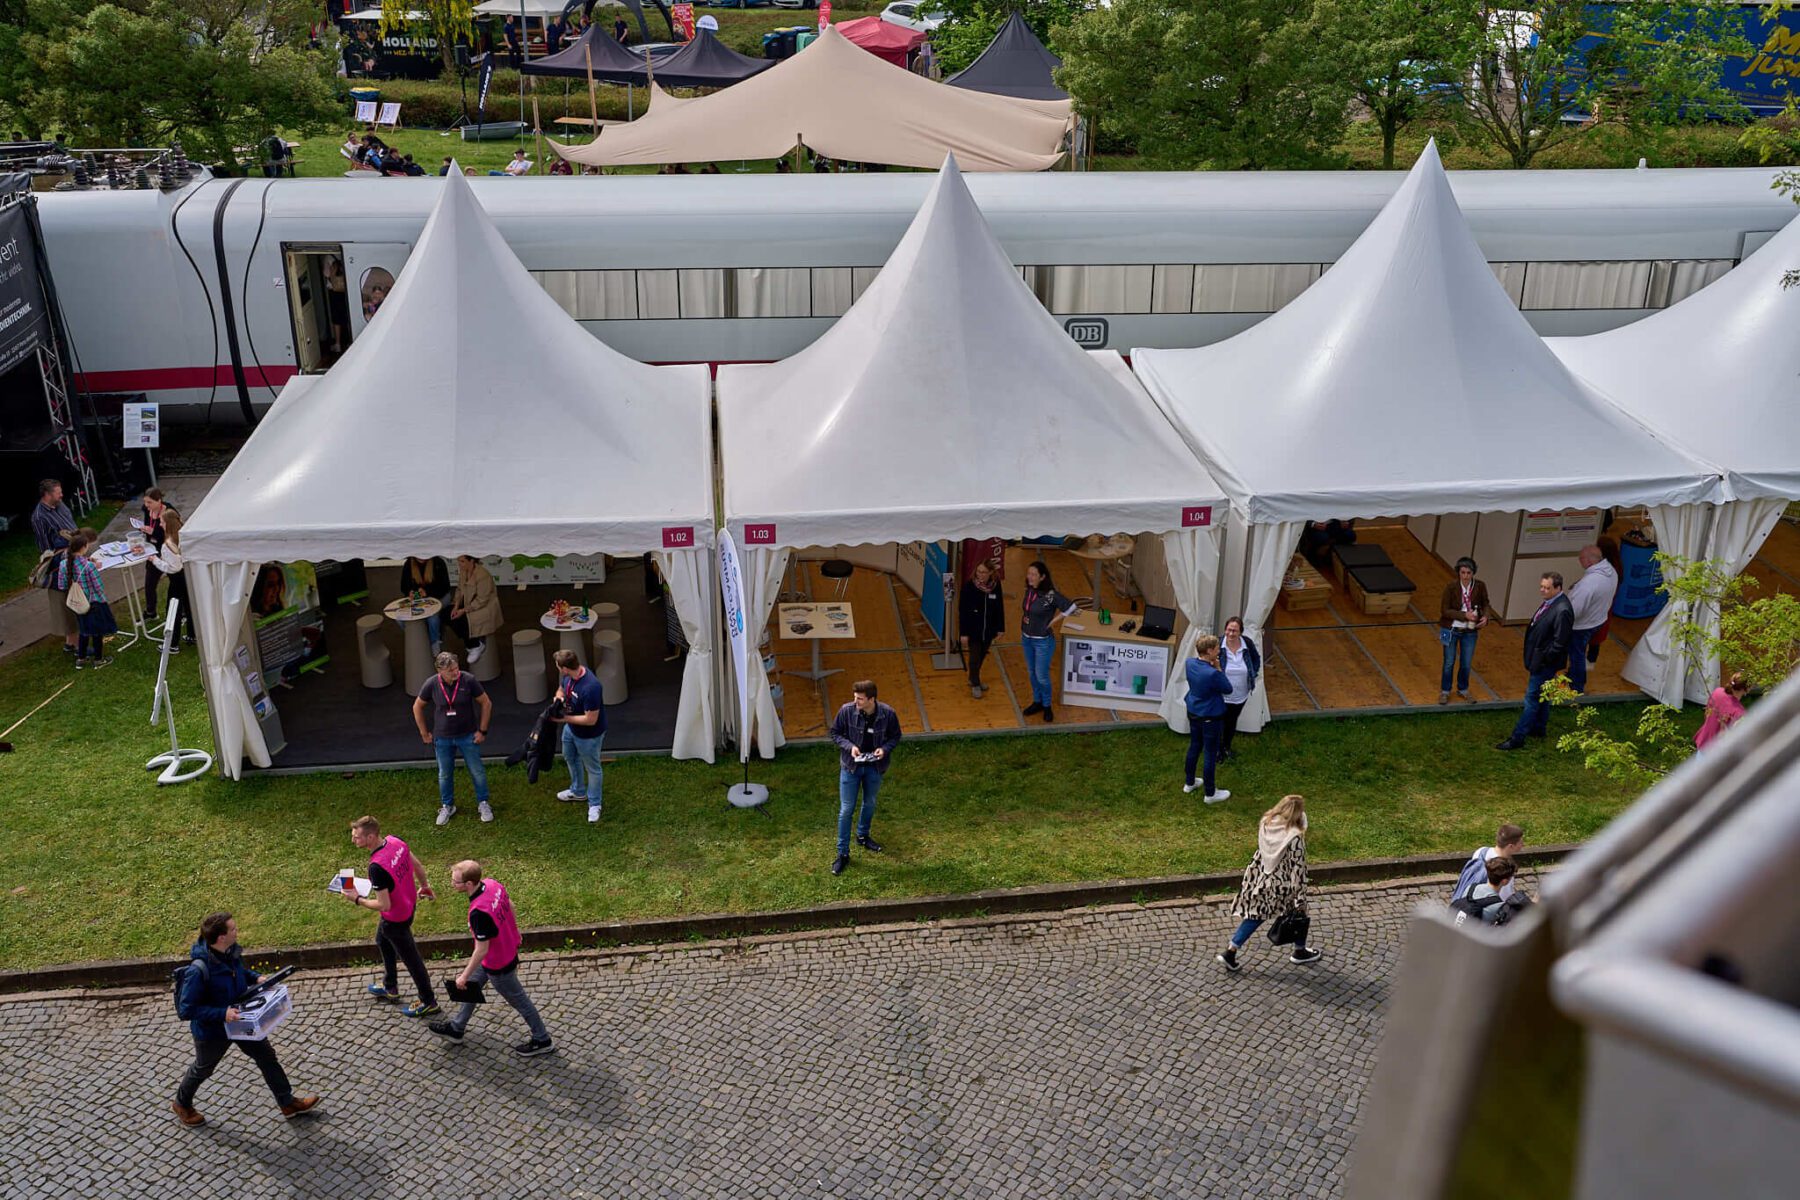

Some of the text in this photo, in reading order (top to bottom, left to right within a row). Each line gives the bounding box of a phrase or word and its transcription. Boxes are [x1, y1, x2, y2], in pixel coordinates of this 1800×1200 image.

[383, 37, 438, 48] HOLLAND
[349, 256, 354, 264] 2
[1073, 326, 1099, 341] DB
[1190, 512, 1204, 521] 1.04
[670, 533, 687, 542] 1.02
[752, 530, 769, 539] 1.03
